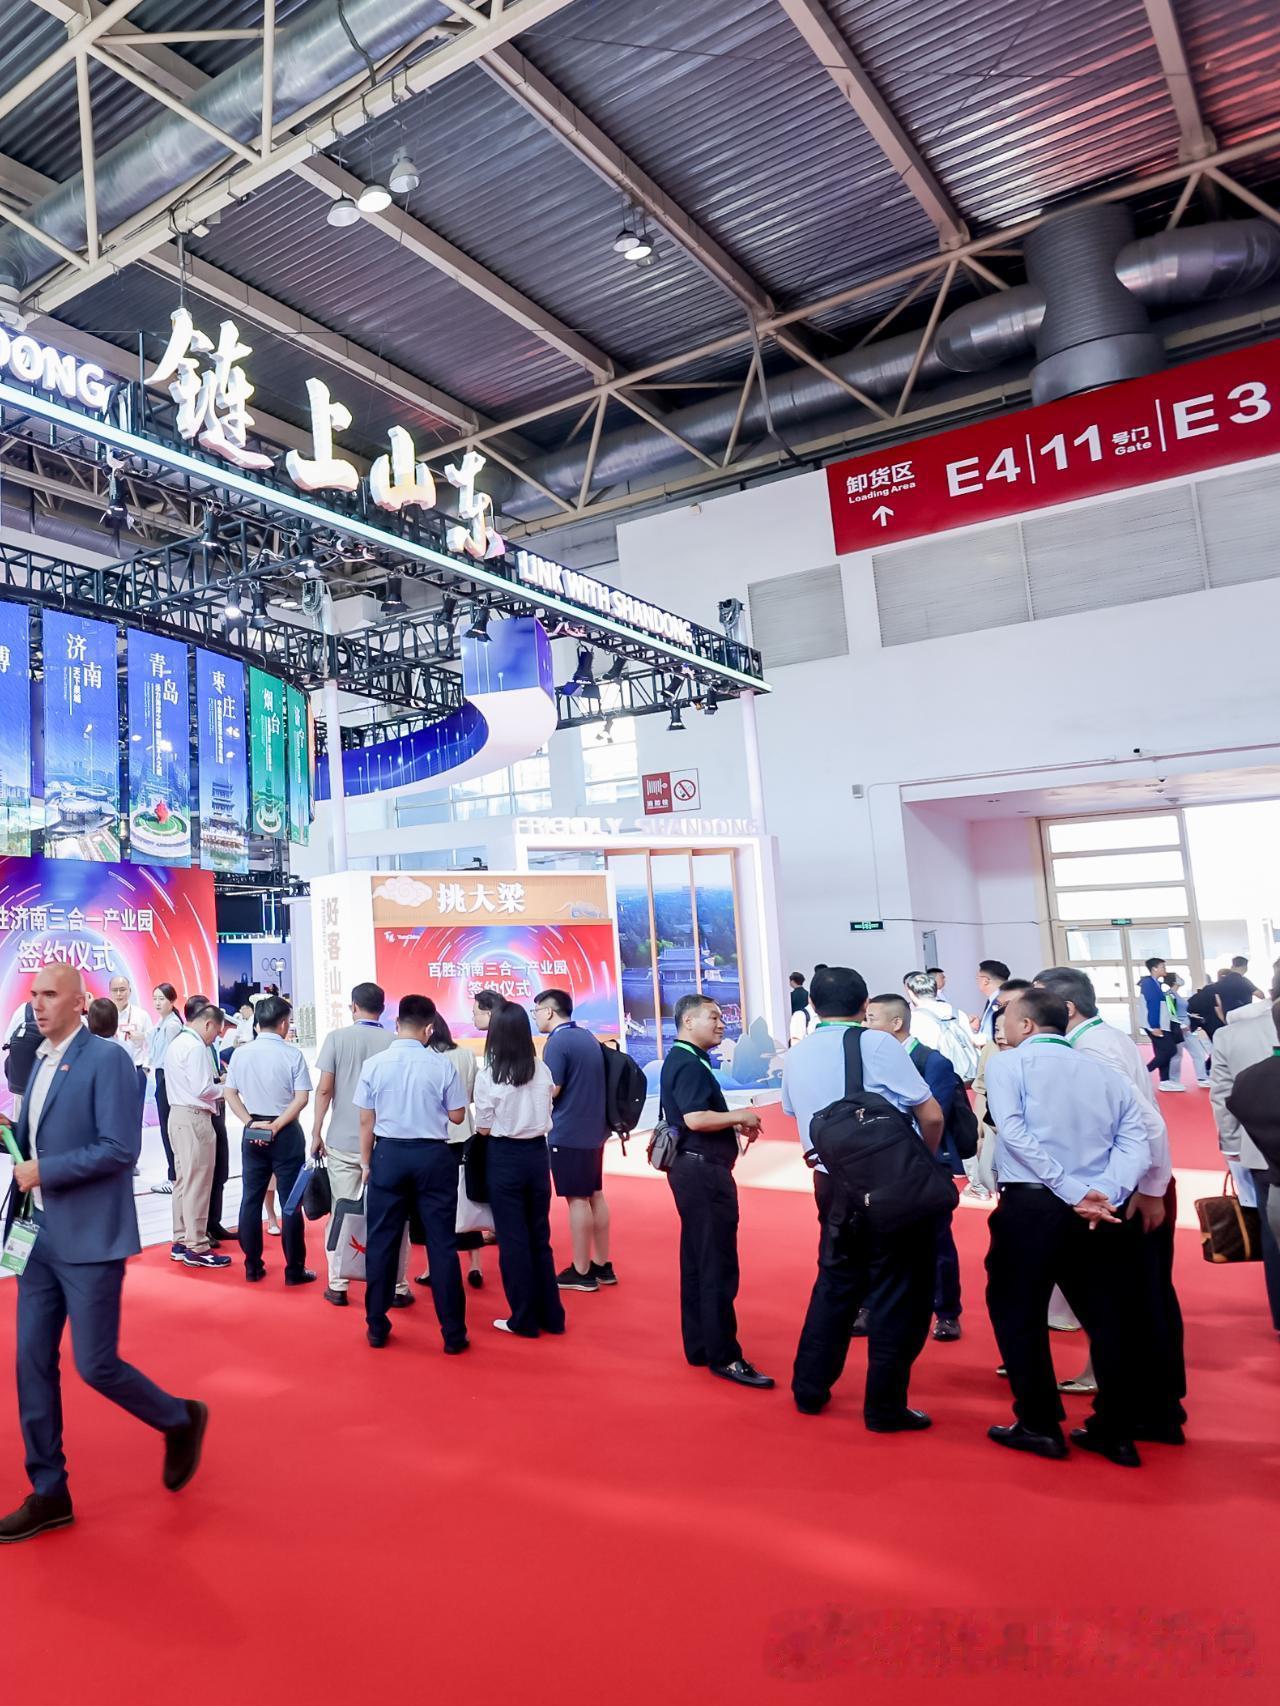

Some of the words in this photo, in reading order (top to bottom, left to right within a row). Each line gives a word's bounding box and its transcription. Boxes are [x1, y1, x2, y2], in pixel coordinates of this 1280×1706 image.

[1173, 381, 1271, 440] E3
[1040, 424, 1102, 470] 11
[1111, 426, 1150, 445] 号门
[1114, 440, 1152, 456] Gate
[846, 461, 915, 494] 卸货区
[946, 447, 1021, 497] E4
[848, 489, 889, 504] Loading
[891, 481, 916, 494] Area
[517, 550, 564, 594] LINK
[562, 569, 610, 614] WITH
[609, 590, 693, 646] SHANDONG
[66, 632, 102, 689] 济南
[149, 652, 179, 705] 青岛
[212, 670, 236, 719] 枣庄
[437, 882, 526, 914] 挑大梁
[19, 939, 116, 974] 签约仪式
[326, 897, 343, 1029] 好客山东
[428, 959, 569, 978] 百胜济南三合一产业园
[468, 979, 532, 999] 签约仪式
